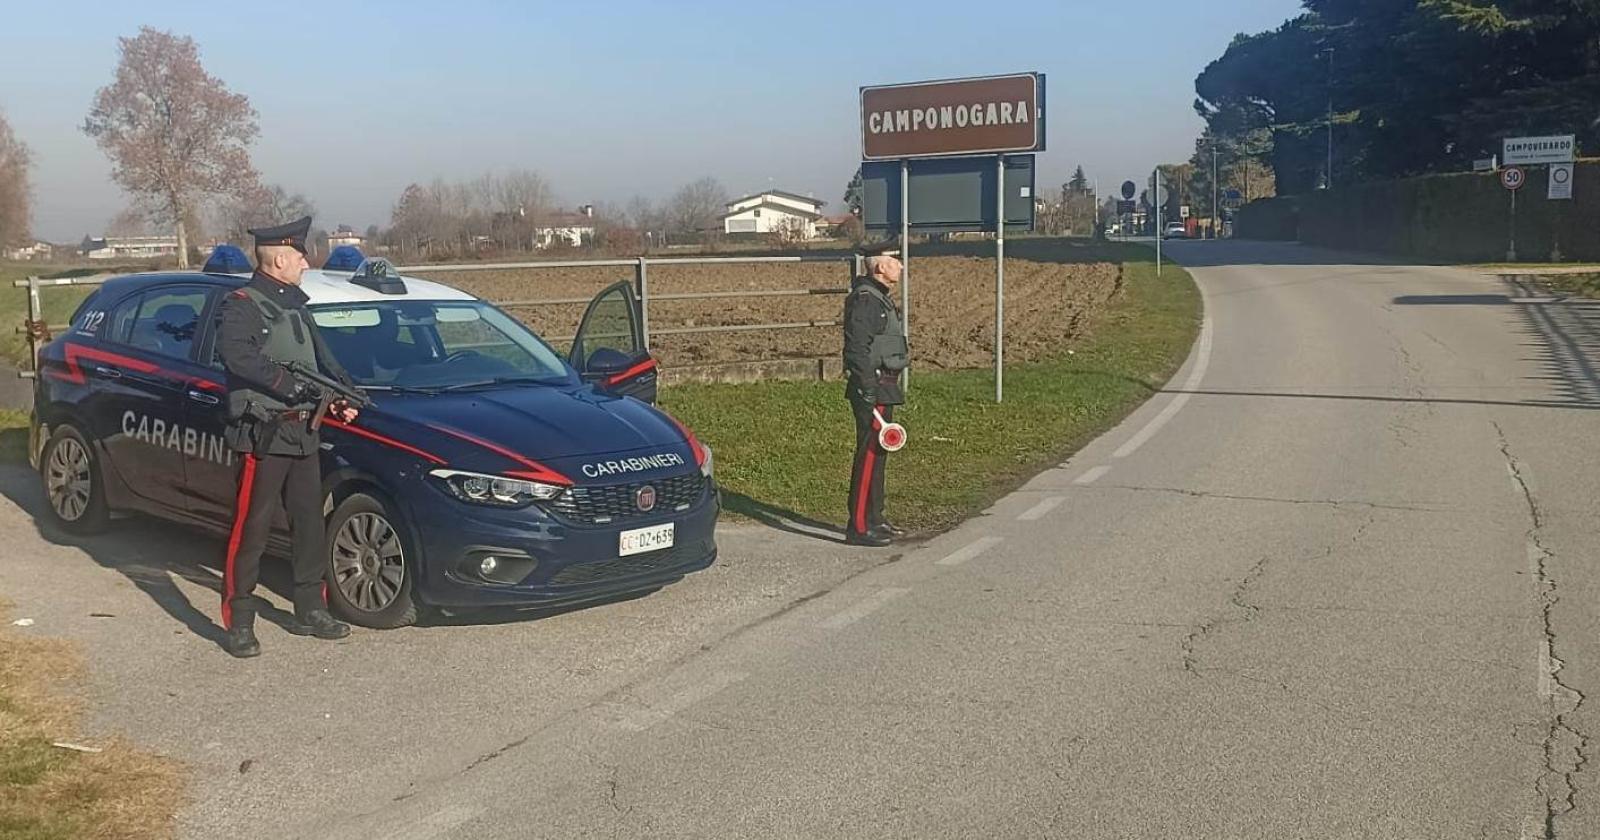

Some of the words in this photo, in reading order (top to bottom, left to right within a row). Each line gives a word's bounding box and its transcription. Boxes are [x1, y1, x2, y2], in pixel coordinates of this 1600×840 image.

[869, 101, 1029, 134] CAMPONOGARA
[1506, 171, 1519, 182] 50
[80, 310, 105, 331] 112
[122, 410, 238, 467] CARABINI
[582, 453, 685, 478] CARABINIERI
